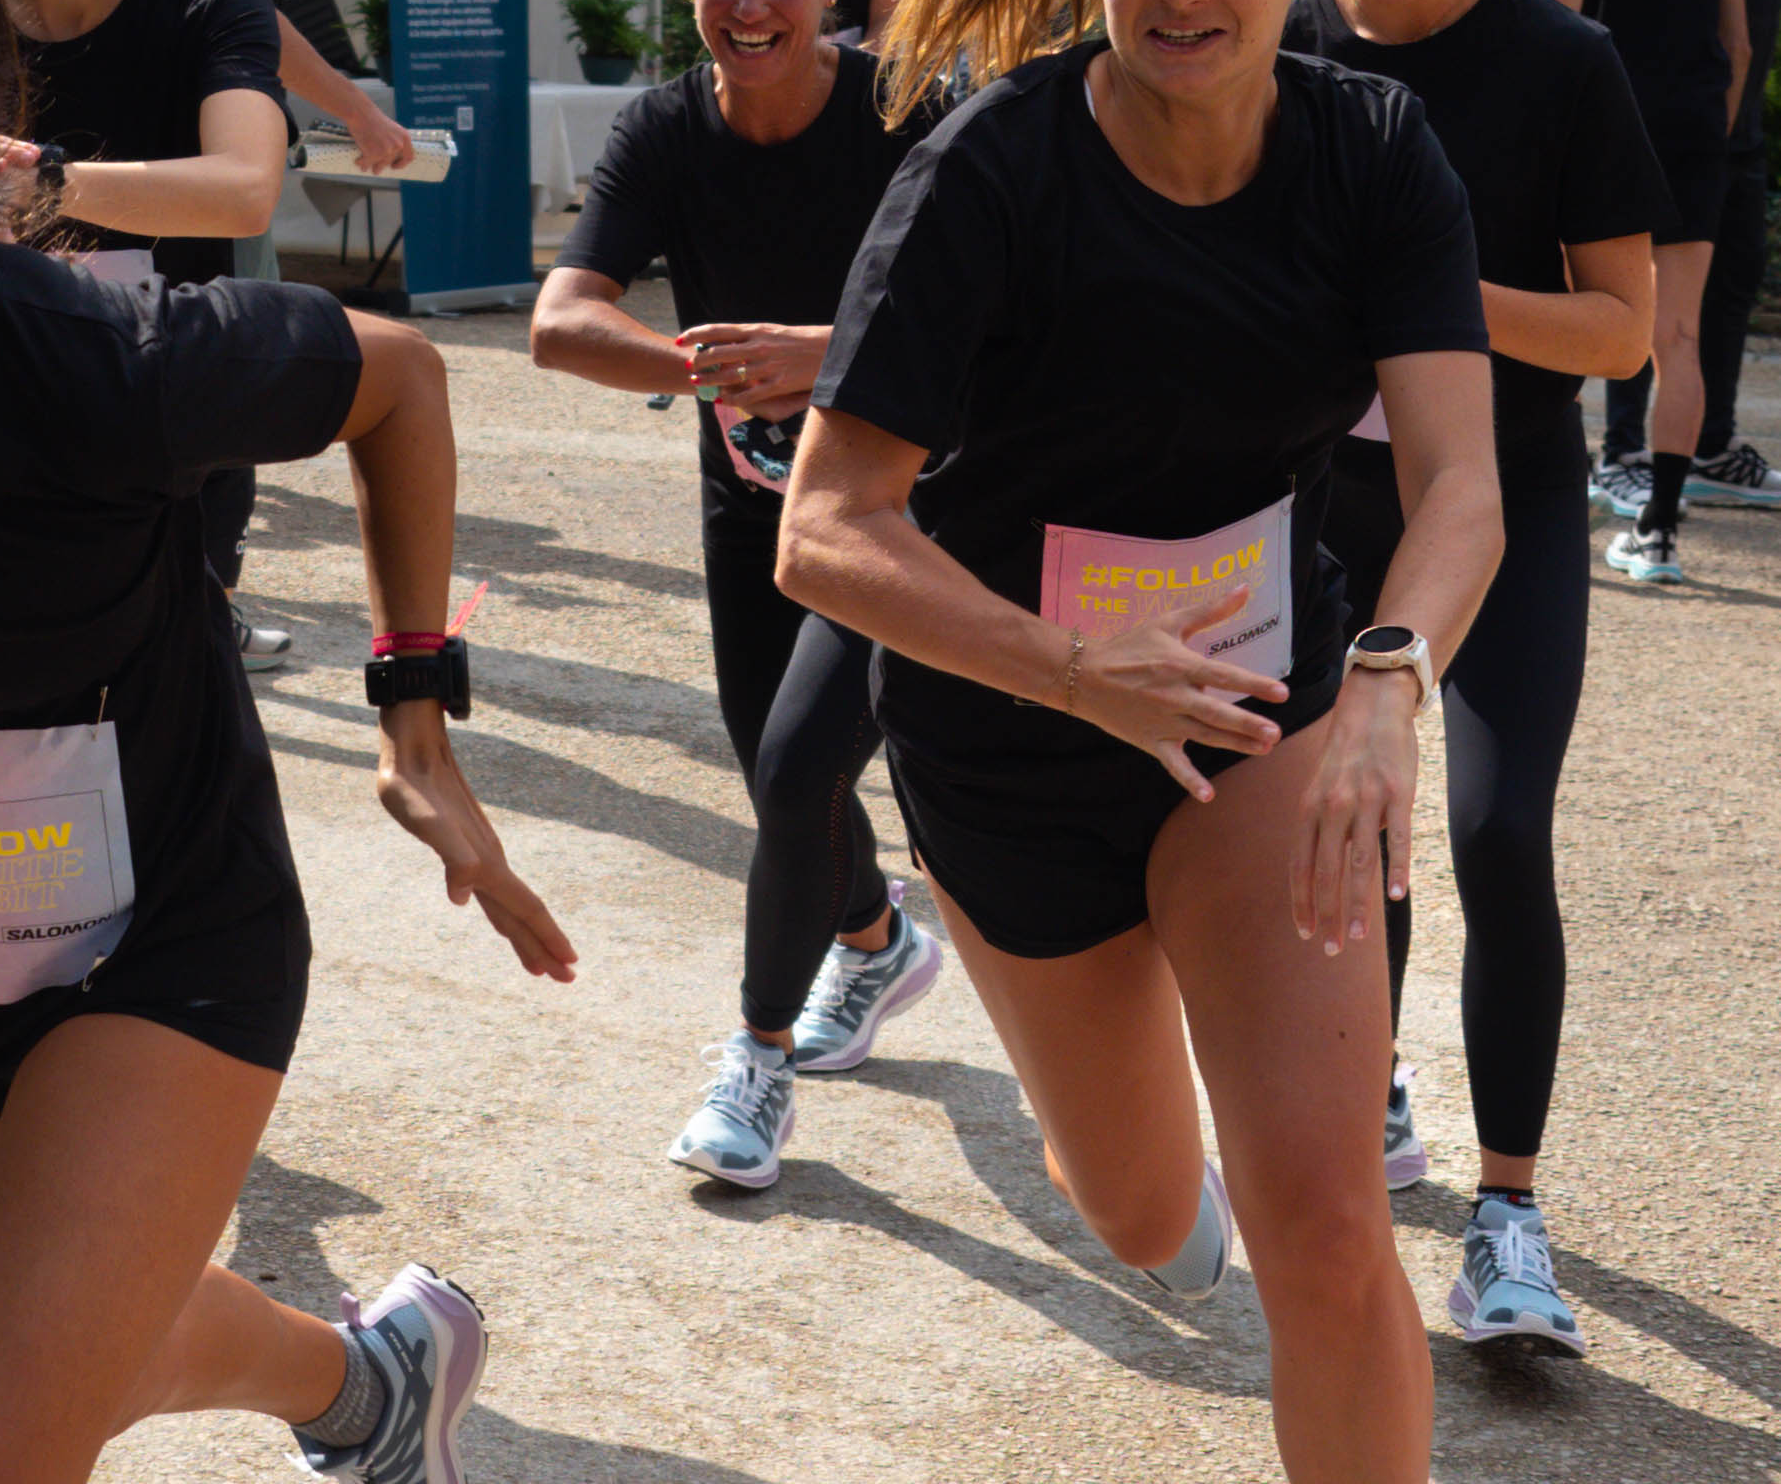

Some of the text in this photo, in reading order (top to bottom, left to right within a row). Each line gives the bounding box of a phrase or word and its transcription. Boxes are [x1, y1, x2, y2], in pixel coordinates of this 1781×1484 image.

[1082, 537, 1266, 591] #FOLLOW
[1076, 594, 1131, 615] THE
[1208, 616, 1280, 656] SALOMON
[6, 913, 112, 941] SALOMON
